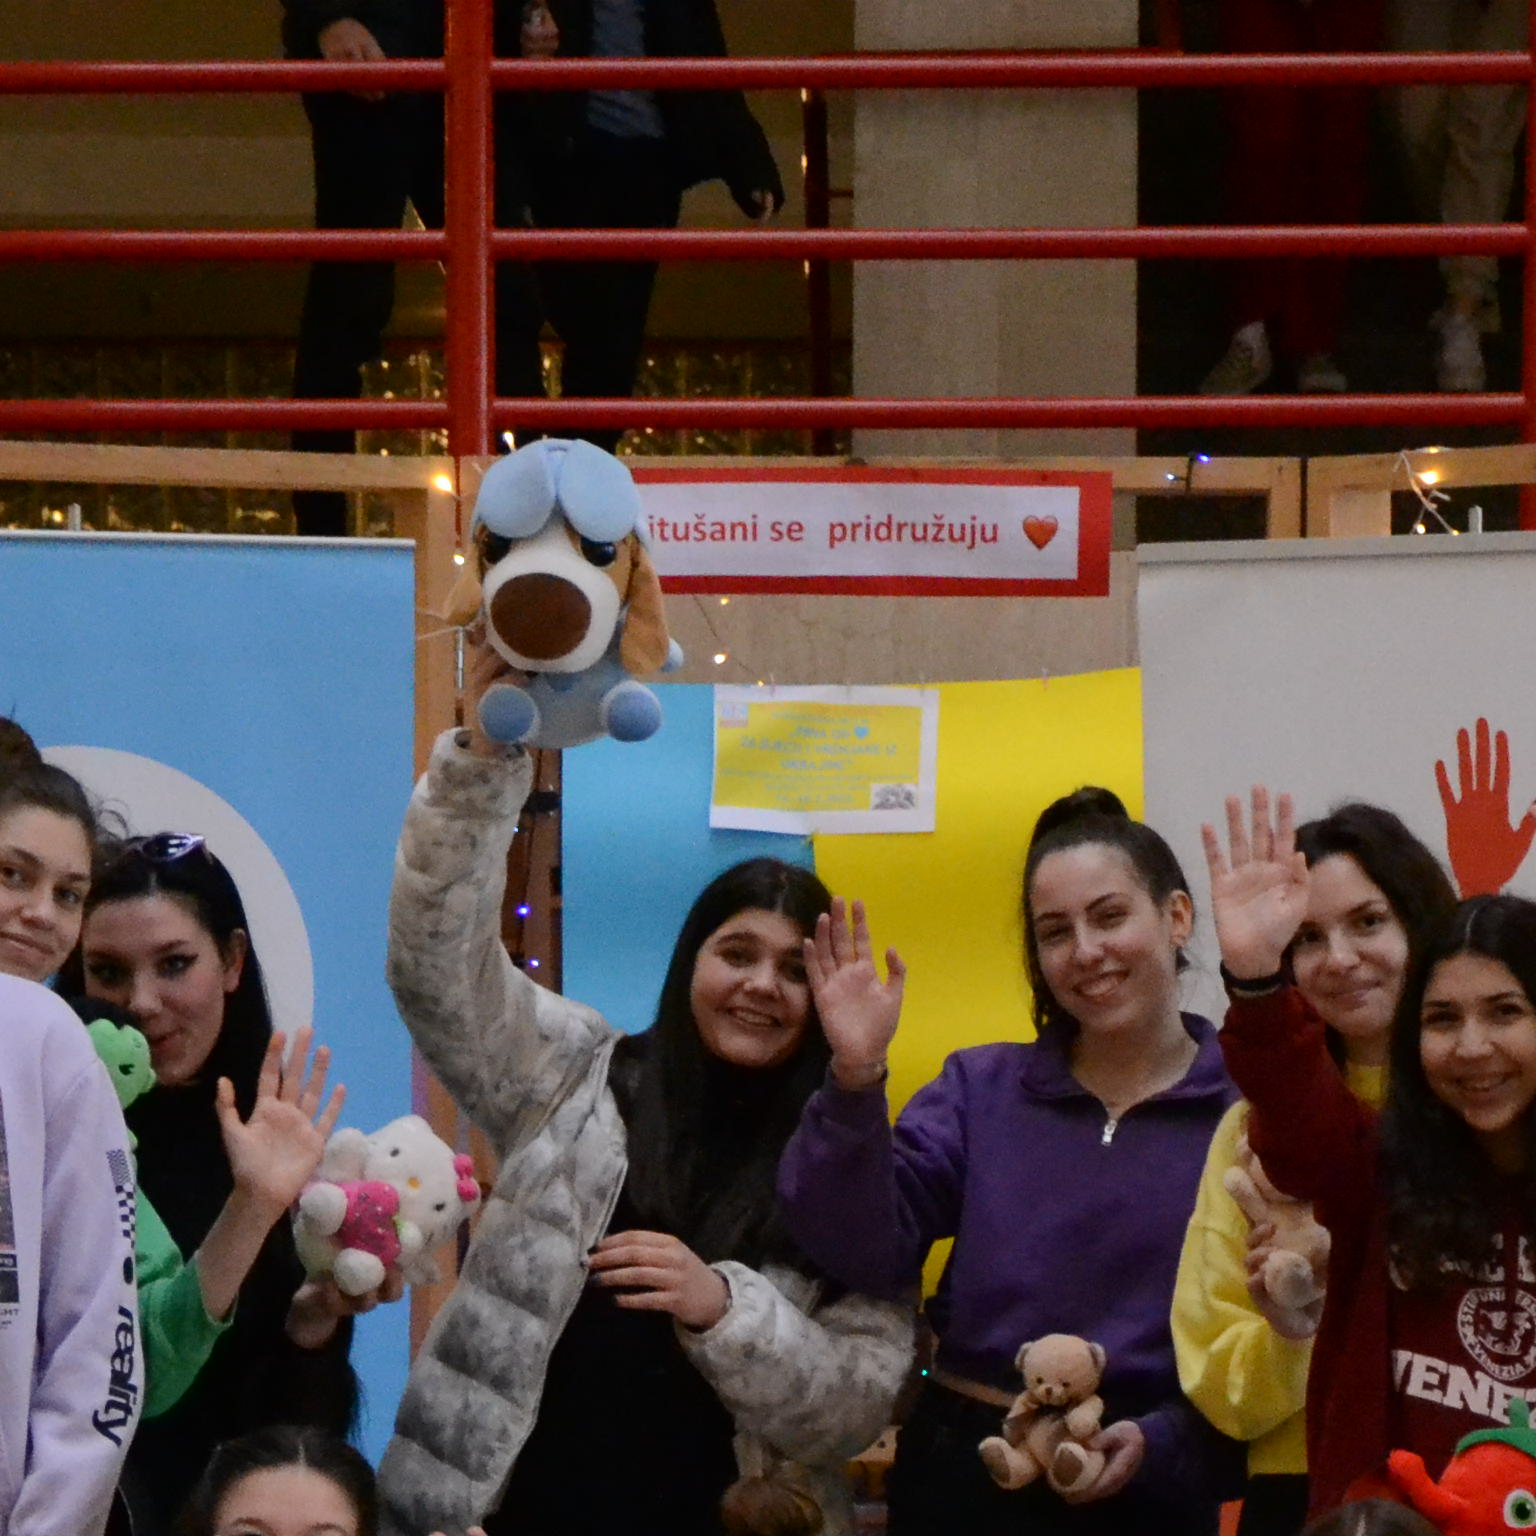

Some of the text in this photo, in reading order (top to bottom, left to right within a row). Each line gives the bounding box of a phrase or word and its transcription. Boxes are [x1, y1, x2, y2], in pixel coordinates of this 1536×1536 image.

[648, 513, 1000, 551] itušani se pridružuju
[92, 1305, 138, 1448] reality
